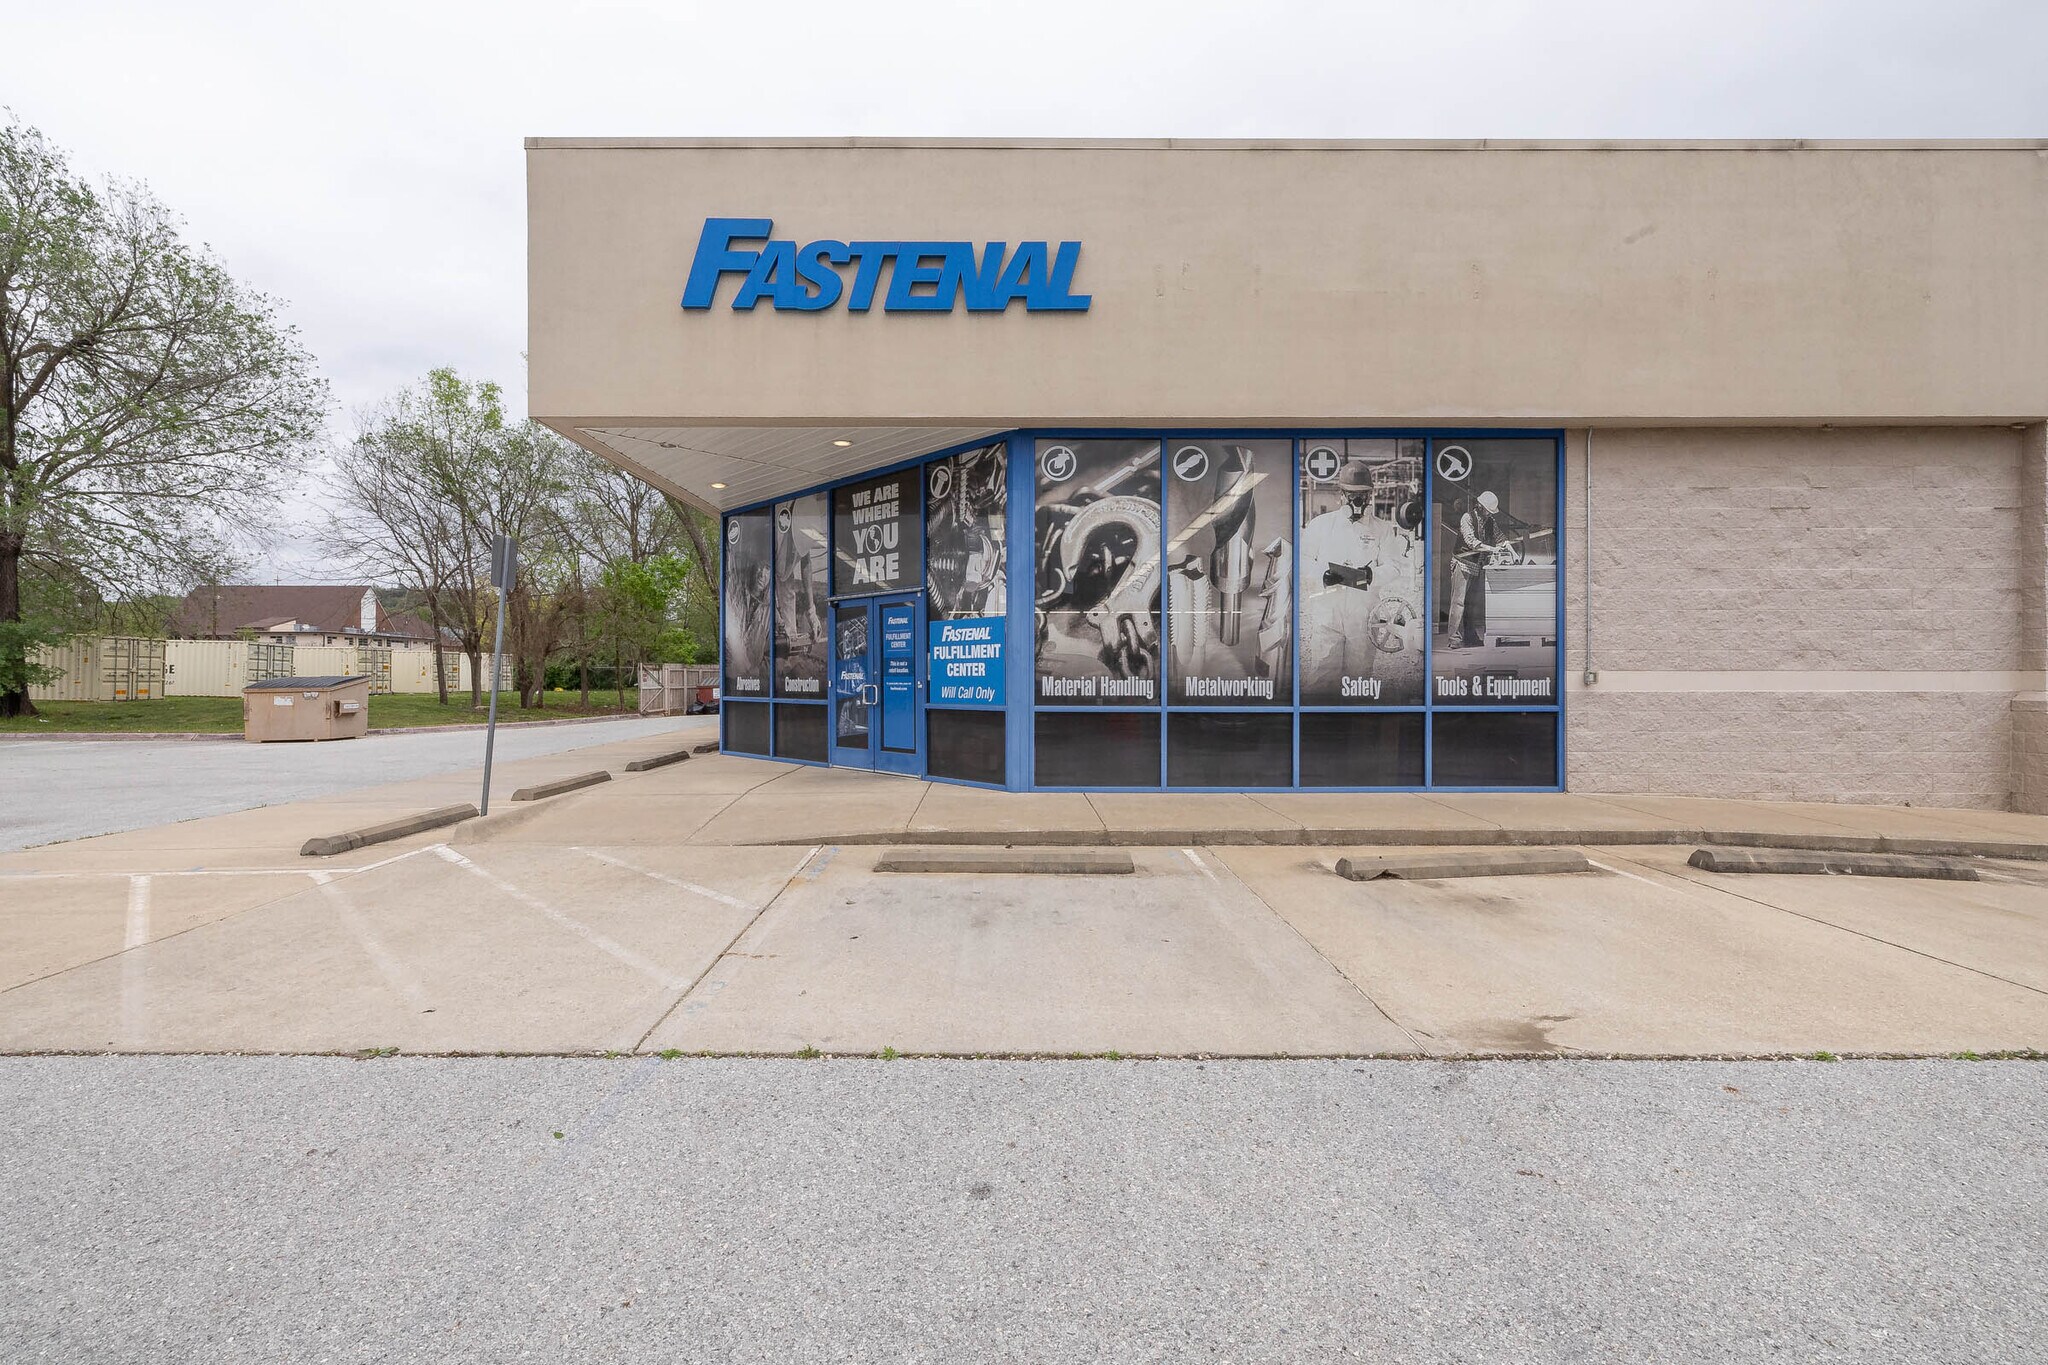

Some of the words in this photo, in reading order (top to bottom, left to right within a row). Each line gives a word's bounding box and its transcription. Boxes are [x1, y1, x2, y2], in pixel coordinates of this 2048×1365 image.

[681, 217, 1092, 313] FASTENAL
[852, 490, 871, 507] WE
[874, 483, 899, 503] ARE
[852, 501, 899, 525] WHERE
[852, 522, 899, 554] YOU
[852, 552, 899, 585] ARE
[886, 632, 911, 640] FULFILLMENT
[941, 626, 991, 642] FASTENAL
[933, 644, 1001, 660] FULFILLMENT
[947, 662, 986, 677] CENTER
[737, 676, 760, 691] Abrasives
[785, 676, 819, 692] Construction
[941, 686, 956, 698] Will
[958, 686, 974, 698] Call
[975, 686, 995, 702] Only
[1042, 676, 1096, 696] Material
[1100, 676, 1154, 699] Handling
[1185, 676, 1273, 699] Metalworking
[1341, 676, 1381, 699] Safety
[1436, 676, 1467, 696] Tools
[1472, 676, 1482, 696] &
[1486, 676, 1551, 699] Equipment
